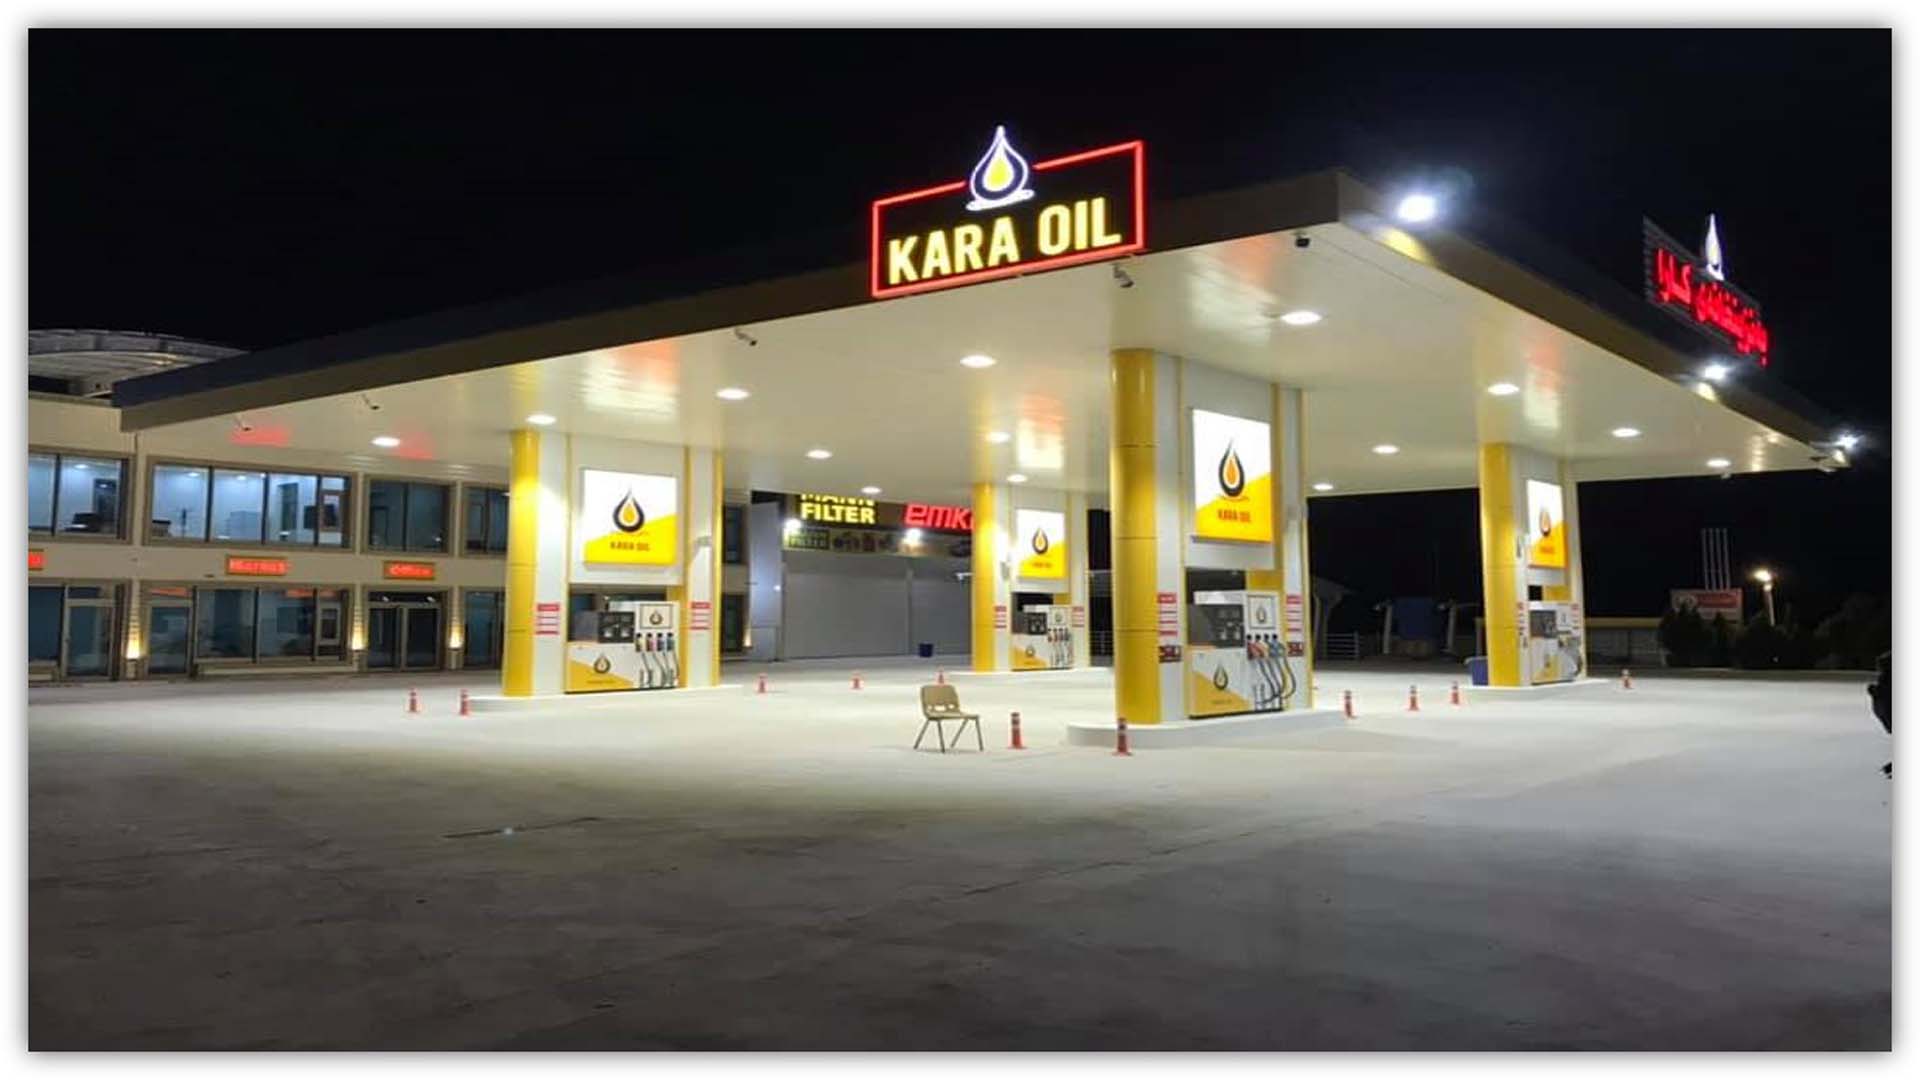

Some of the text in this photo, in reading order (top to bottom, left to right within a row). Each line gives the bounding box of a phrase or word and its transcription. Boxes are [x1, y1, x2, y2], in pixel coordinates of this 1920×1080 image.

[889, 197, 1122, 285] KARA OIL
[800, 502, 876, 525] FILTER
